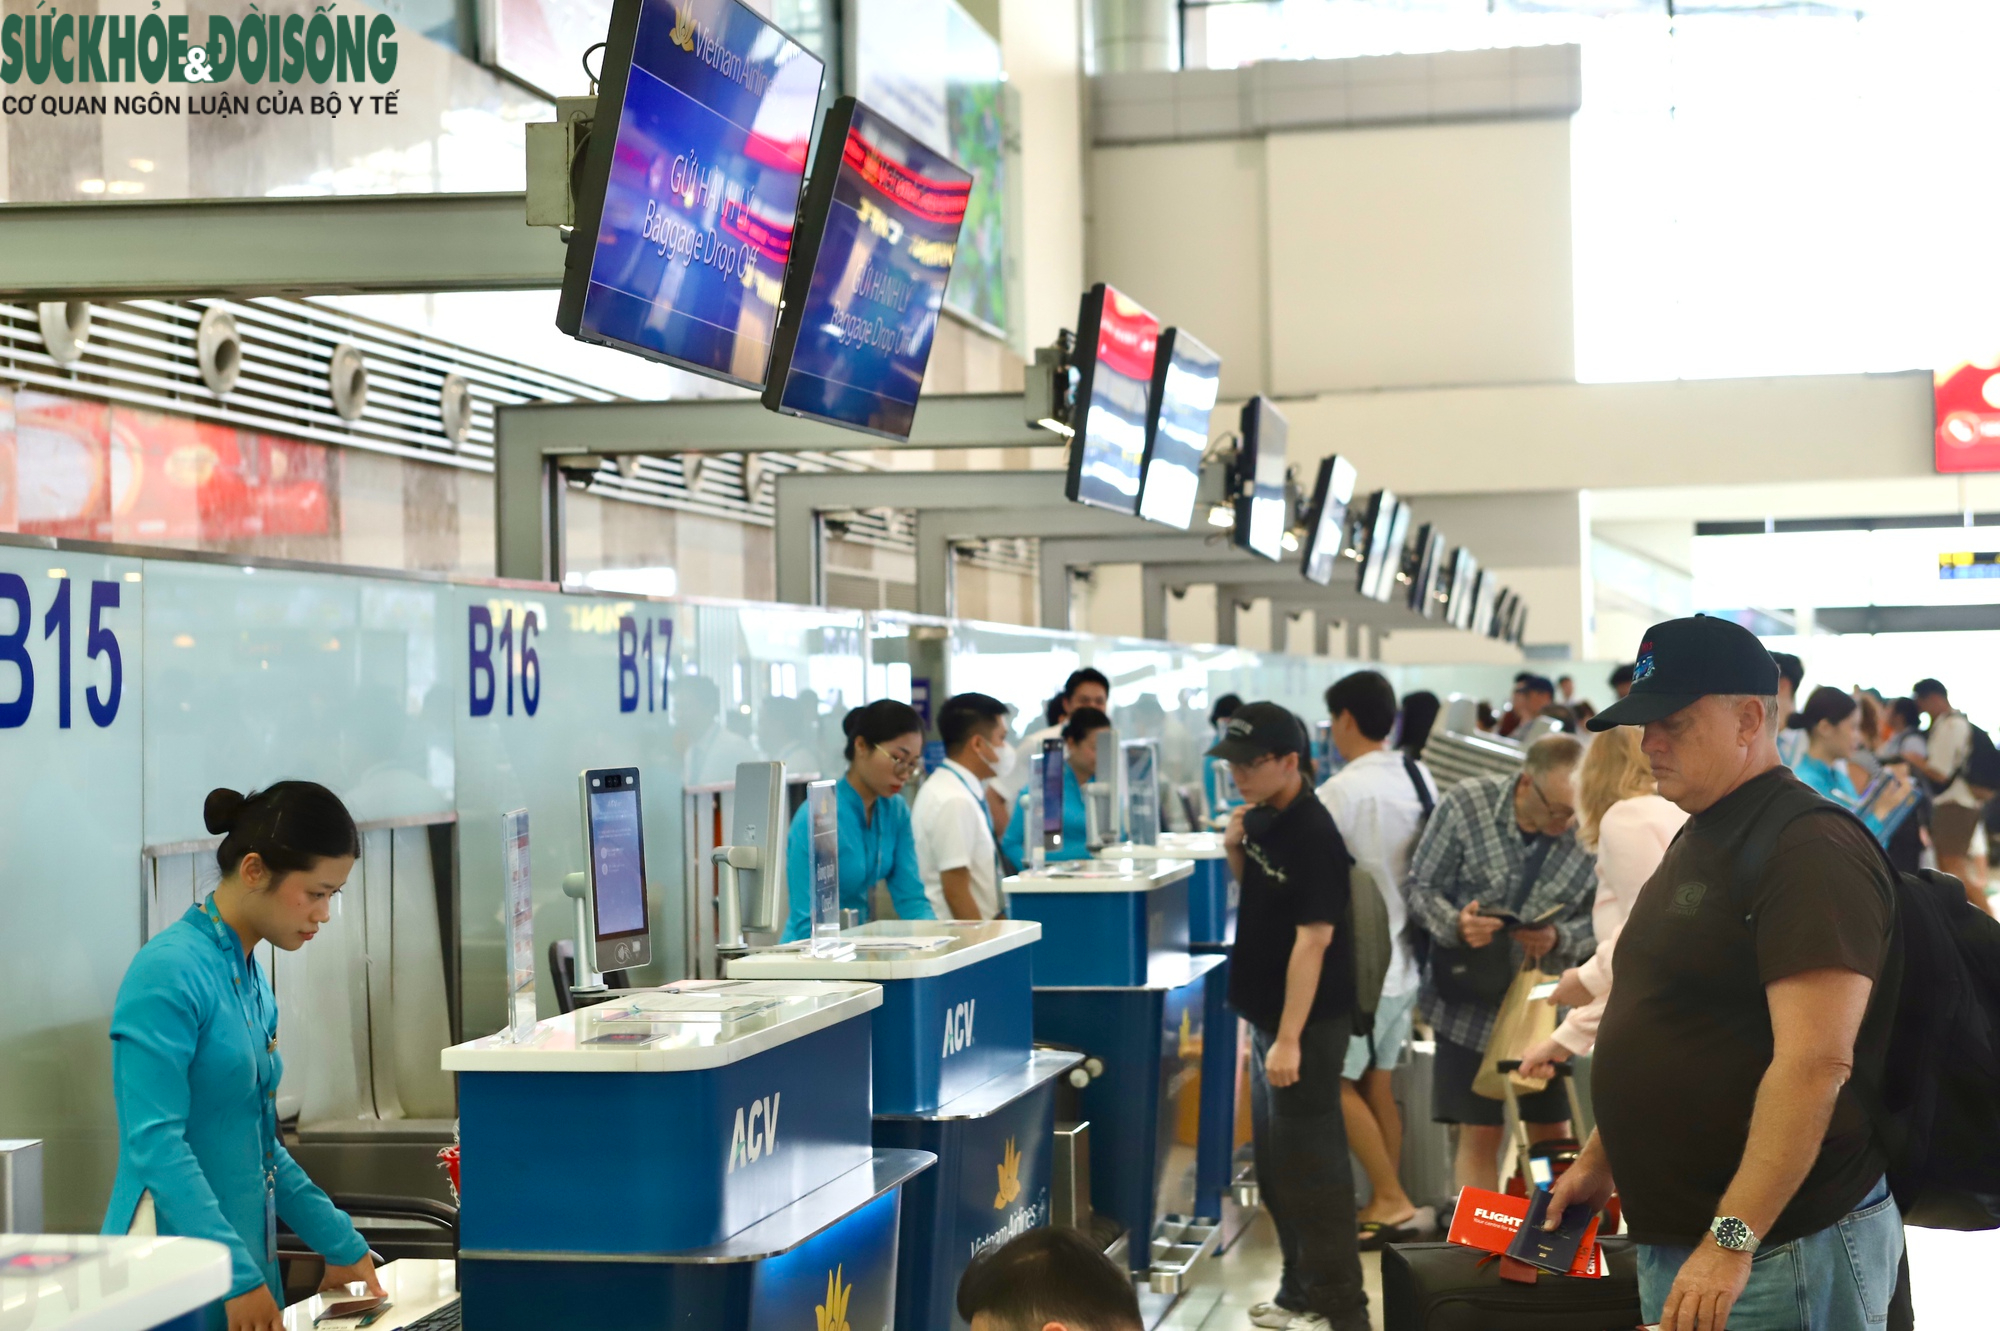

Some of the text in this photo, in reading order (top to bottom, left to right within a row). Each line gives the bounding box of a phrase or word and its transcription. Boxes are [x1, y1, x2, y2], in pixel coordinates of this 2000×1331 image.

[696, 21, 742, 85] Vietnam
[670, 148, 756, 227] GỬI HÀNH LÝ
[642, 198, 760, 282] Baggage Drop Off
[830, 300, 873, 351] Baggage
[871, 317, 896, 359] Drop
[0, 572, 123, 729] B15
[468, 605, 541, 717] B16
[618, 616, 673, 714] B17
[942, 999, 975, 1059] ACV
[728, 1091, 781, 1175] ACV
[1473, 1207, 1524, 1228] FLIGHT
[1473, 1217, 1485, 1225] Your
[1484, 1220, 1501, 1229] centre
